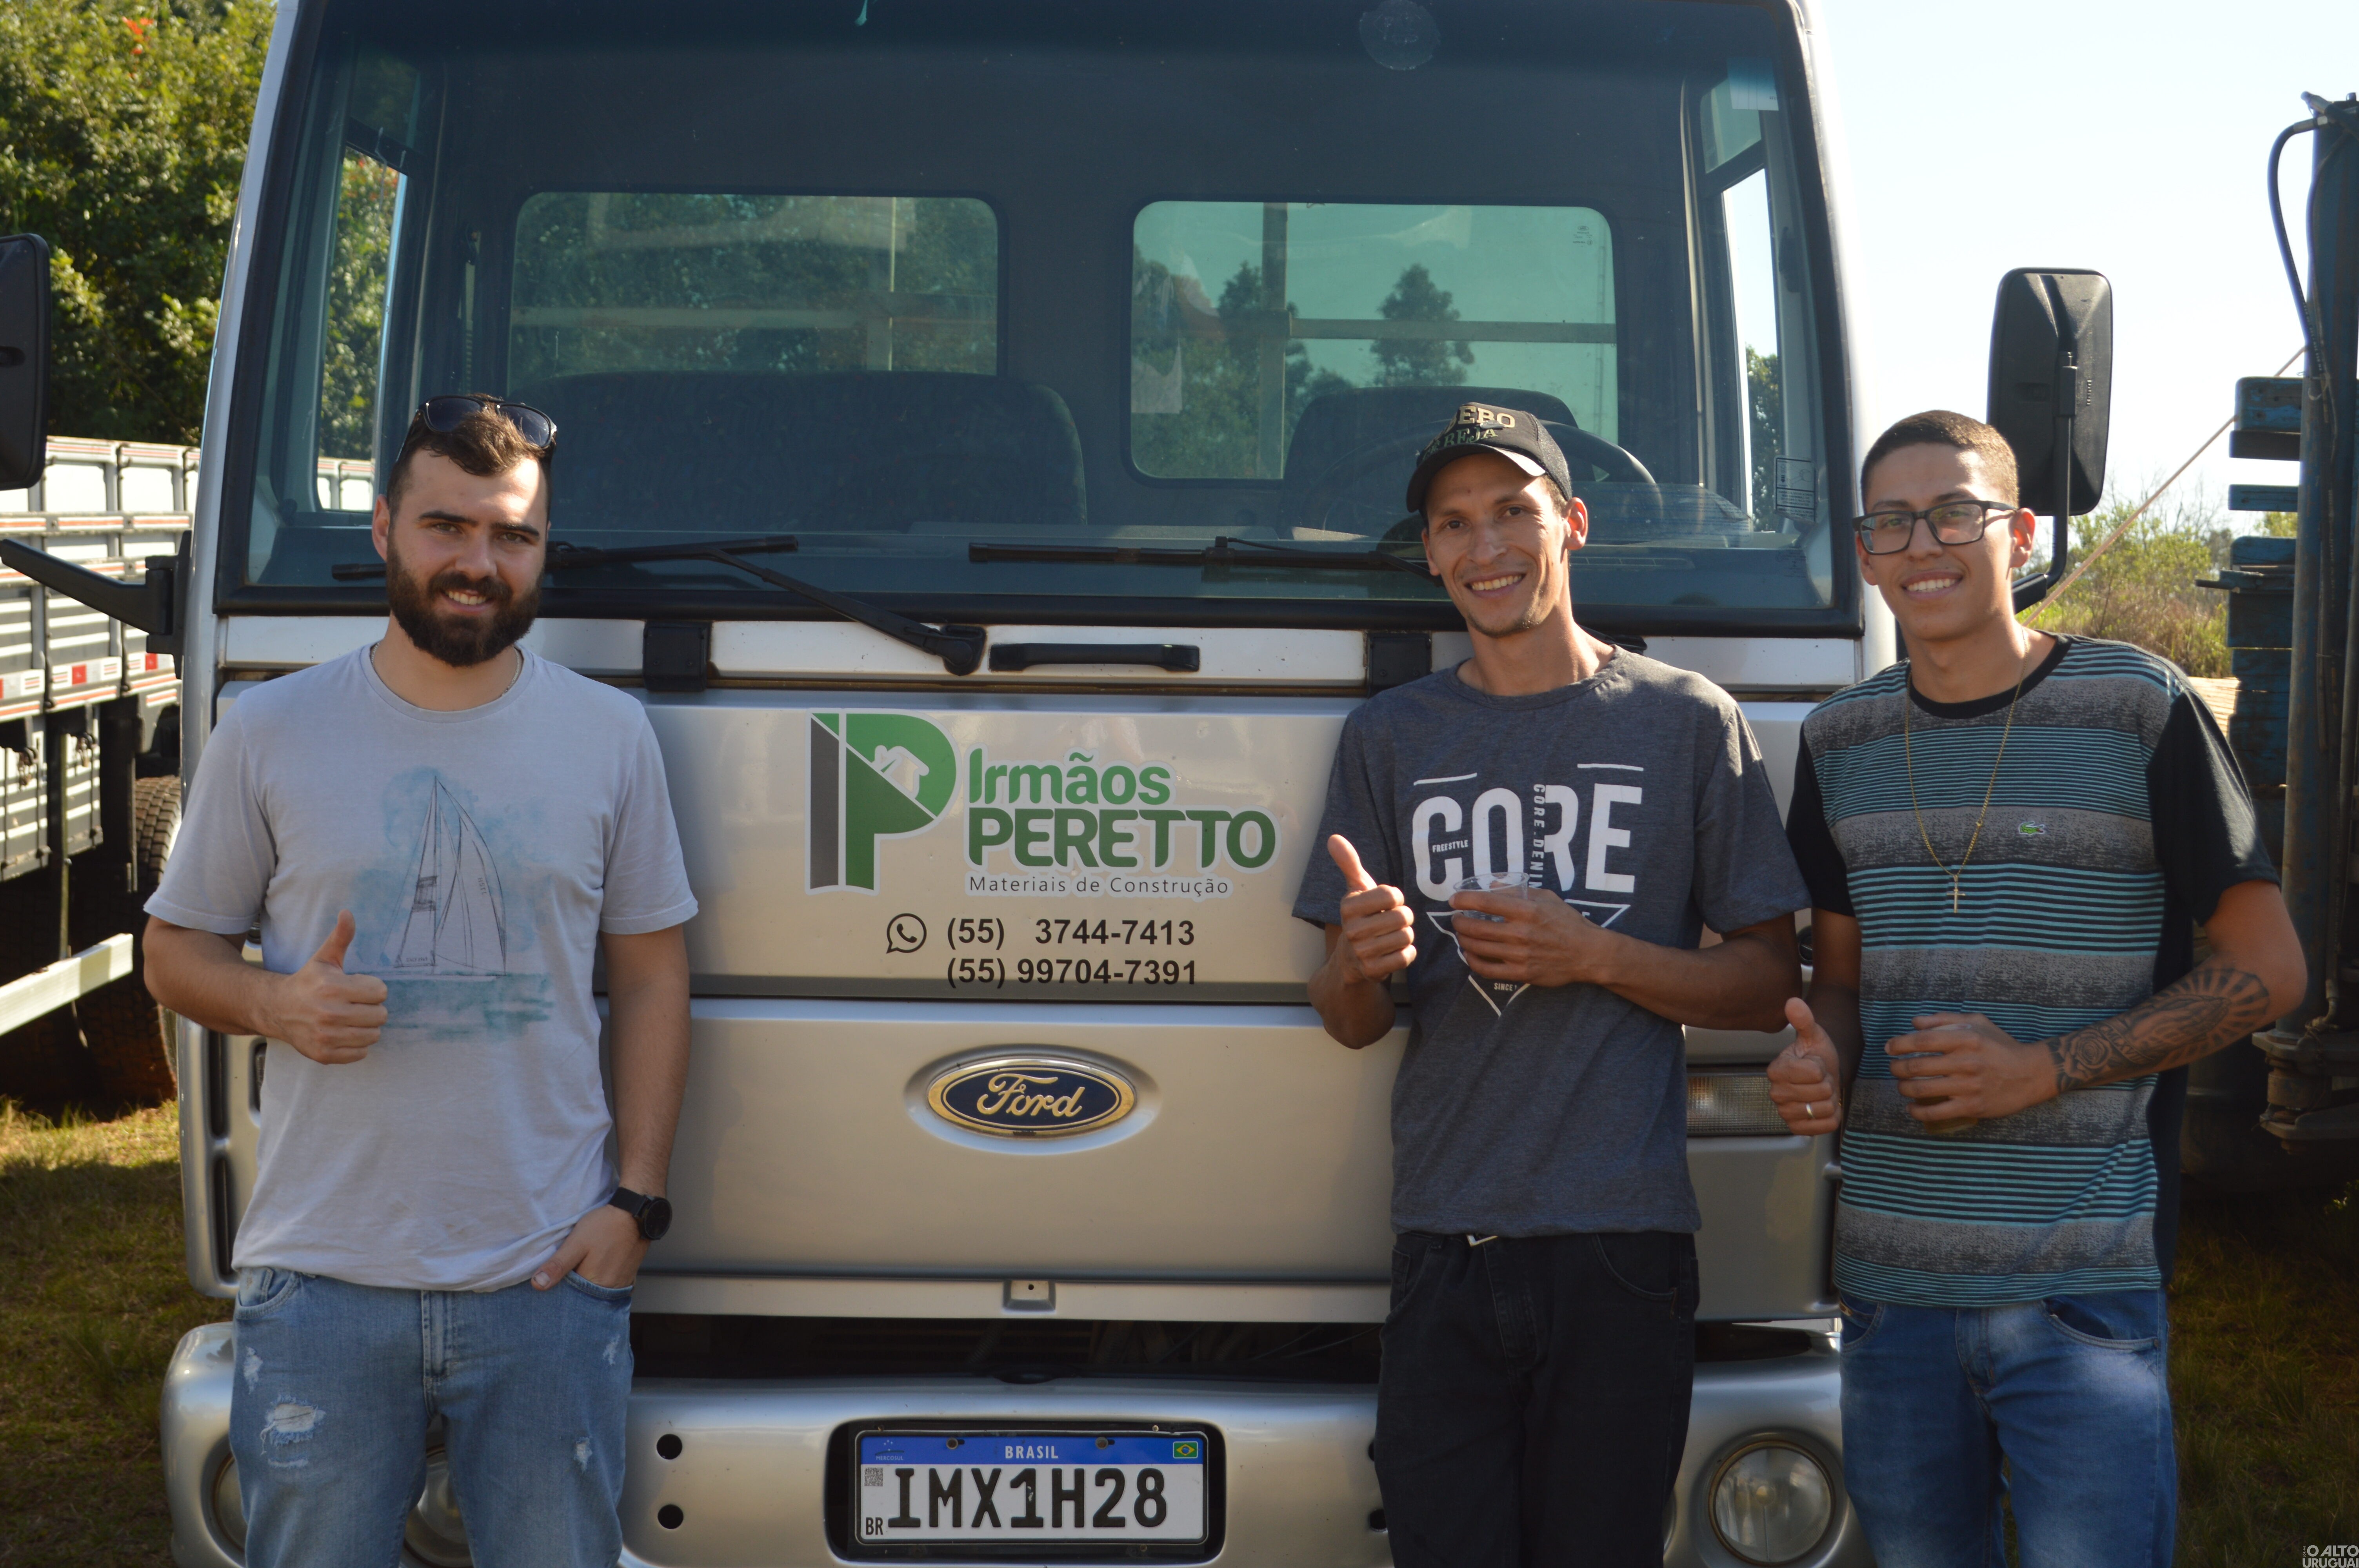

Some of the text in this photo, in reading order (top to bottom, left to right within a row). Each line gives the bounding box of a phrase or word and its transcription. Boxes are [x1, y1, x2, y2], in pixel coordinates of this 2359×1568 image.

[969, 748, 1171, 805] Irmãos
[969, 807, 1276, 868] PERETTO
[1412, 783, 1642, 901] CORE
[1432, 840, 1468, 853] FREESTYLE
[970, 876, 1228, 897] Materiais de Construção
[947, 917, 1195, 950] (55) 3744-7413
[947, 958, 1196, 989] (55) 99704-7391
[1494, 982, 1513, 991] SINCE
[977, 1073, 1085, 1118] Ford
[1005, 1446, 1059, 1459] BRASIL
[888, 1468, 1167, 1528] IMX1H28
[865, 1517, 883, 1535] BR
